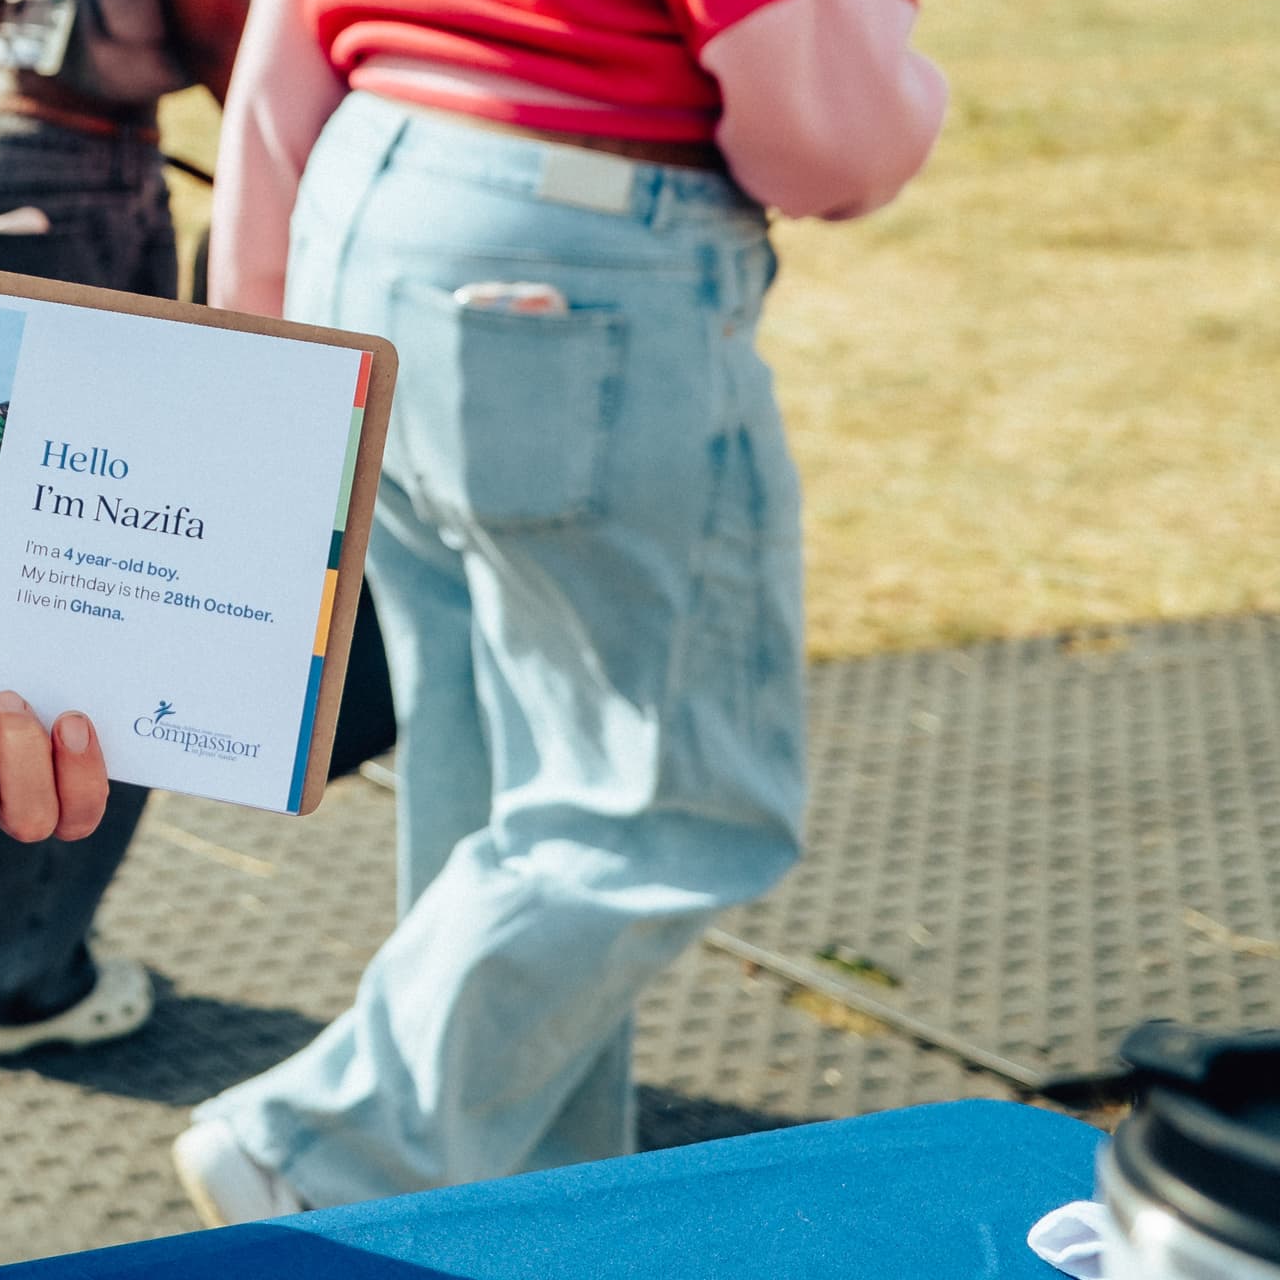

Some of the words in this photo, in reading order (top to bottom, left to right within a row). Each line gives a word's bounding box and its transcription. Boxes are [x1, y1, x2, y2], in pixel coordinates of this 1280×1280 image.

[41, 440, 129, 480] Hello
[93, 494, 205, 539] Nazifa
[51, 547, 61, 559] a
[63, 547, 74, 561] 4
[76, 551, 143, 573] year-old
[147, 560, 180, 581] boy.
[16, 588, 22, 602] I
[24, 589, 50, 607] live
[53, 596, 67, 610] in
[70, 599, 125, 621] Ghana.
[21, 564, 46, 582] My
[49, 569, 115, 597] birthday
[118, 582, 131, 597] is
[135, 585, 161, 602] the
[163, 590, 200, 609] 28th
[204, 598, 274, 624] October.
